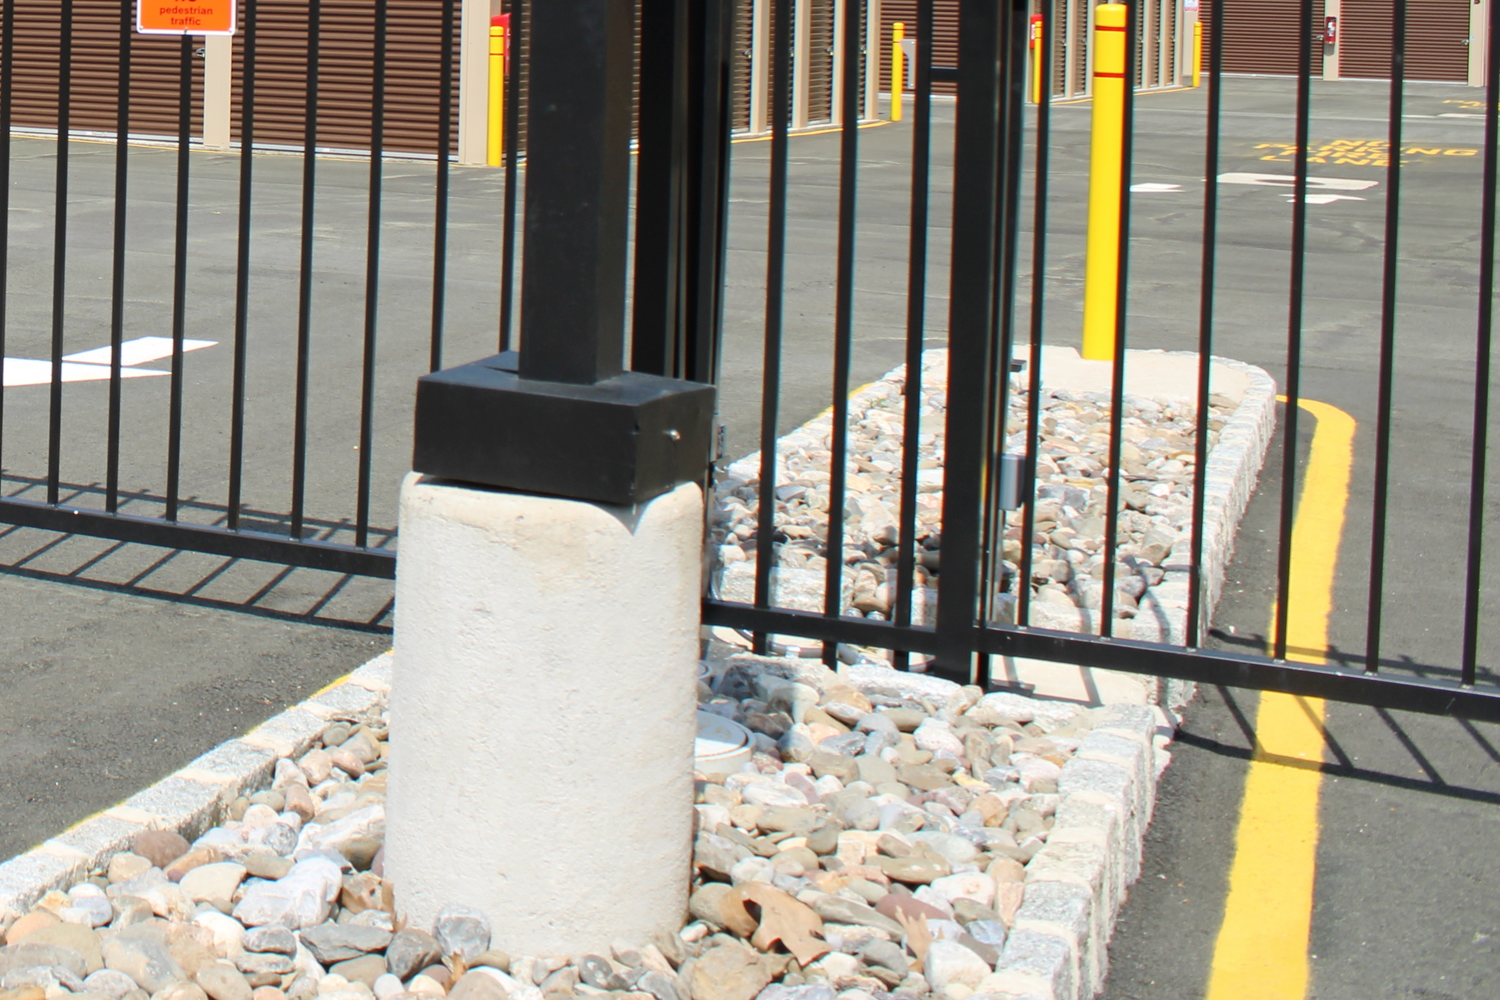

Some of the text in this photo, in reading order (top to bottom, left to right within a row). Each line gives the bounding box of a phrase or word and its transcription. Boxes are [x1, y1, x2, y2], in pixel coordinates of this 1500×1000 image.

[159, 6, 213, 15] pedestrian
[171, 17, 202, 26] traffic
[1253, 143, 1479, 156] PARKNG
